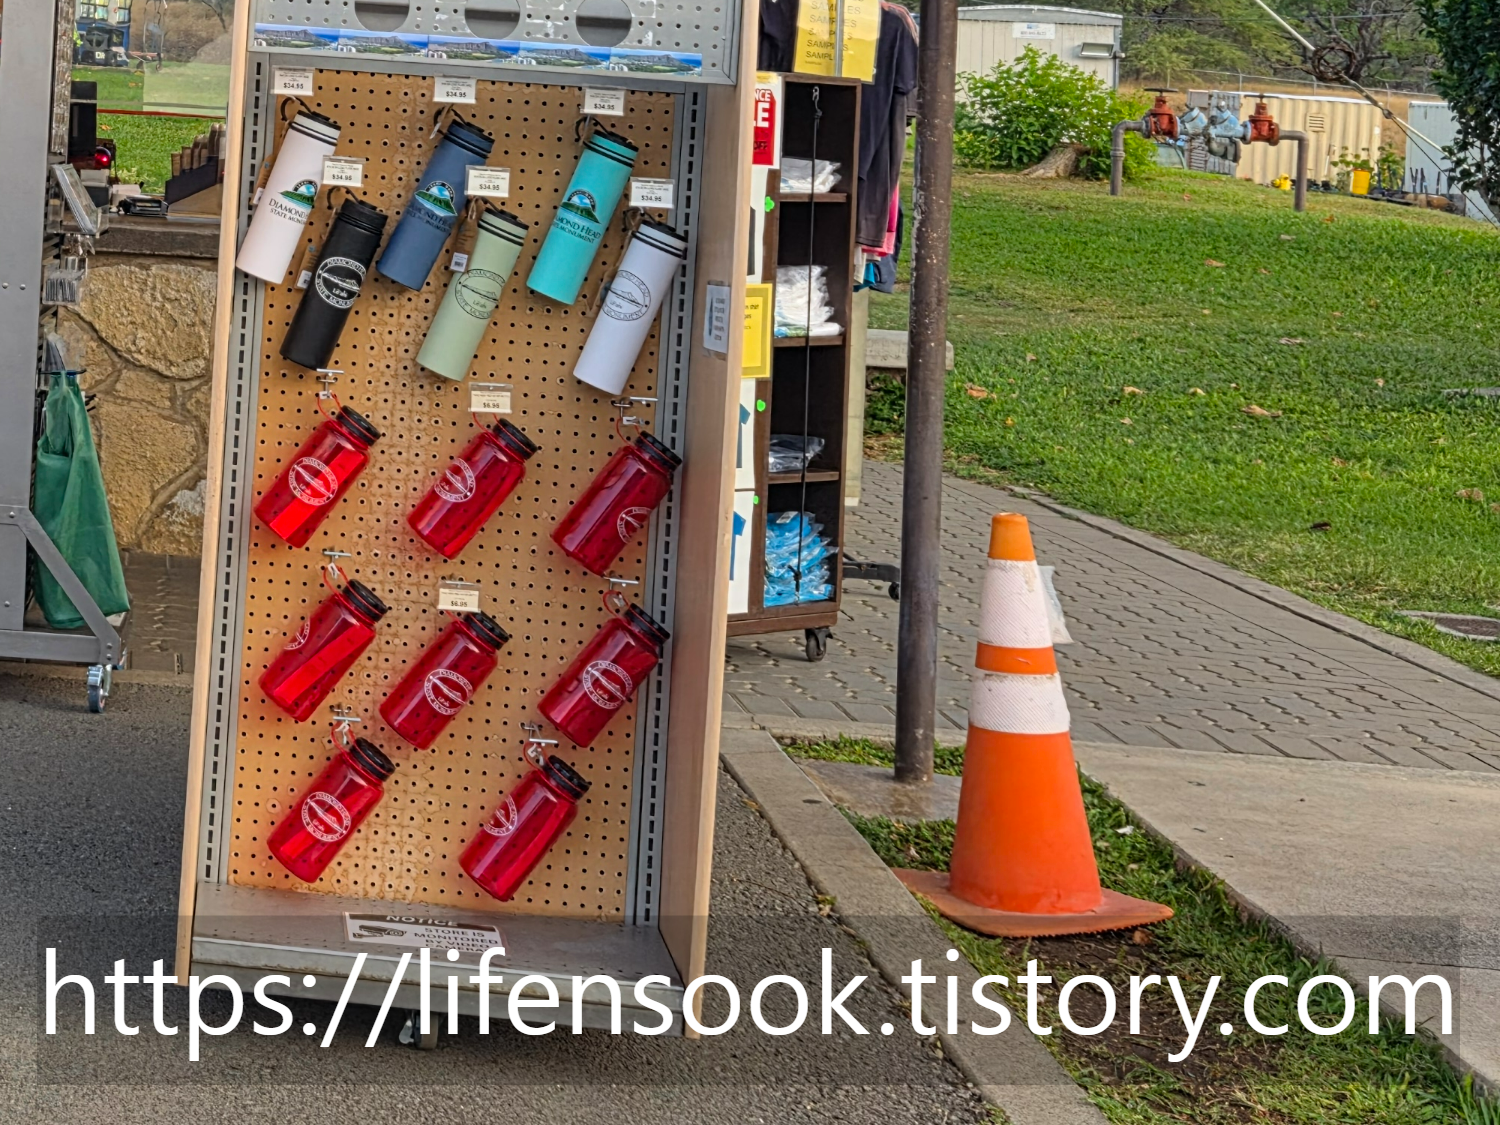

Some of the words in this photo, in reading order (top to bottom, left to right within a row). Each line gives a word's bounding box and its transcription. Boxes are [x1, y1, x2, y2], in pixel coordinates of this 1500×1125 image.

[332, 173, 352, 181] $34.95
[478, 183, 500, 191] $34.95
[641, 195, 662, 203] $34.95
[270, 209, 287, 220] STATE
[580, 225, 601, 239] HEAD
[386, 915, 458, 927] NOTICE
[424, 927, 469, 935] STORE
[414, 932, 498, 945] MONITORED
[450, 941, 490, 949] VIDEO
